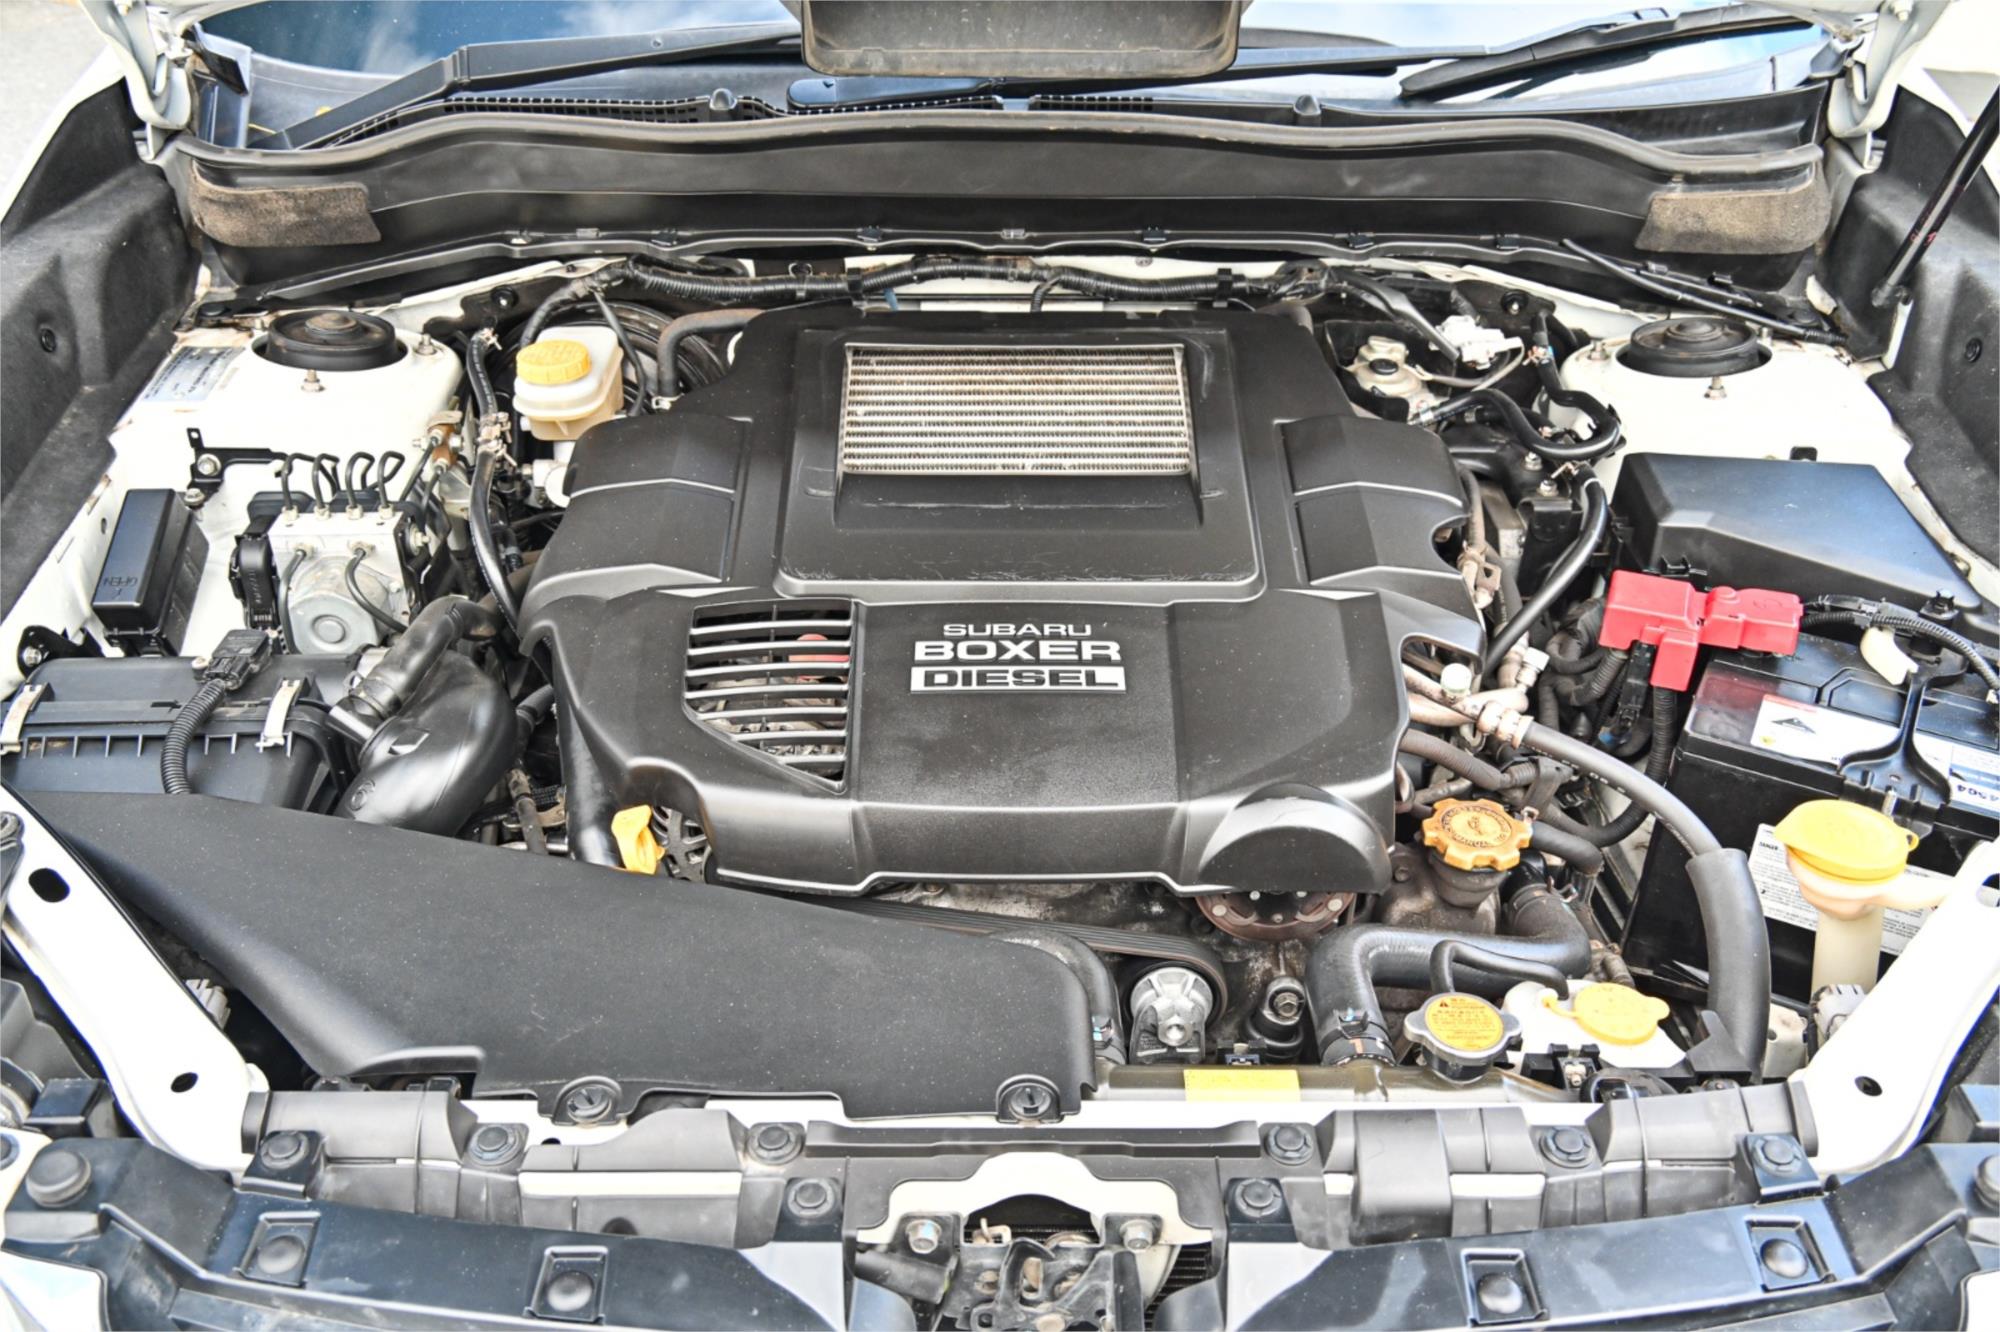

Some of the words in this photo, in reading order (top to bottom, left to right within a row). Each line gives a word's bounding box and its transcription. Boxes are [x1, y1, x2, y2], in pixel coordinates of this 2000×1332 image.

[943, 623, 1091, 638] SUBARU
[914, 640, 1121, 661] BOXER
[924, 669, 1118, 687] DIESEL
